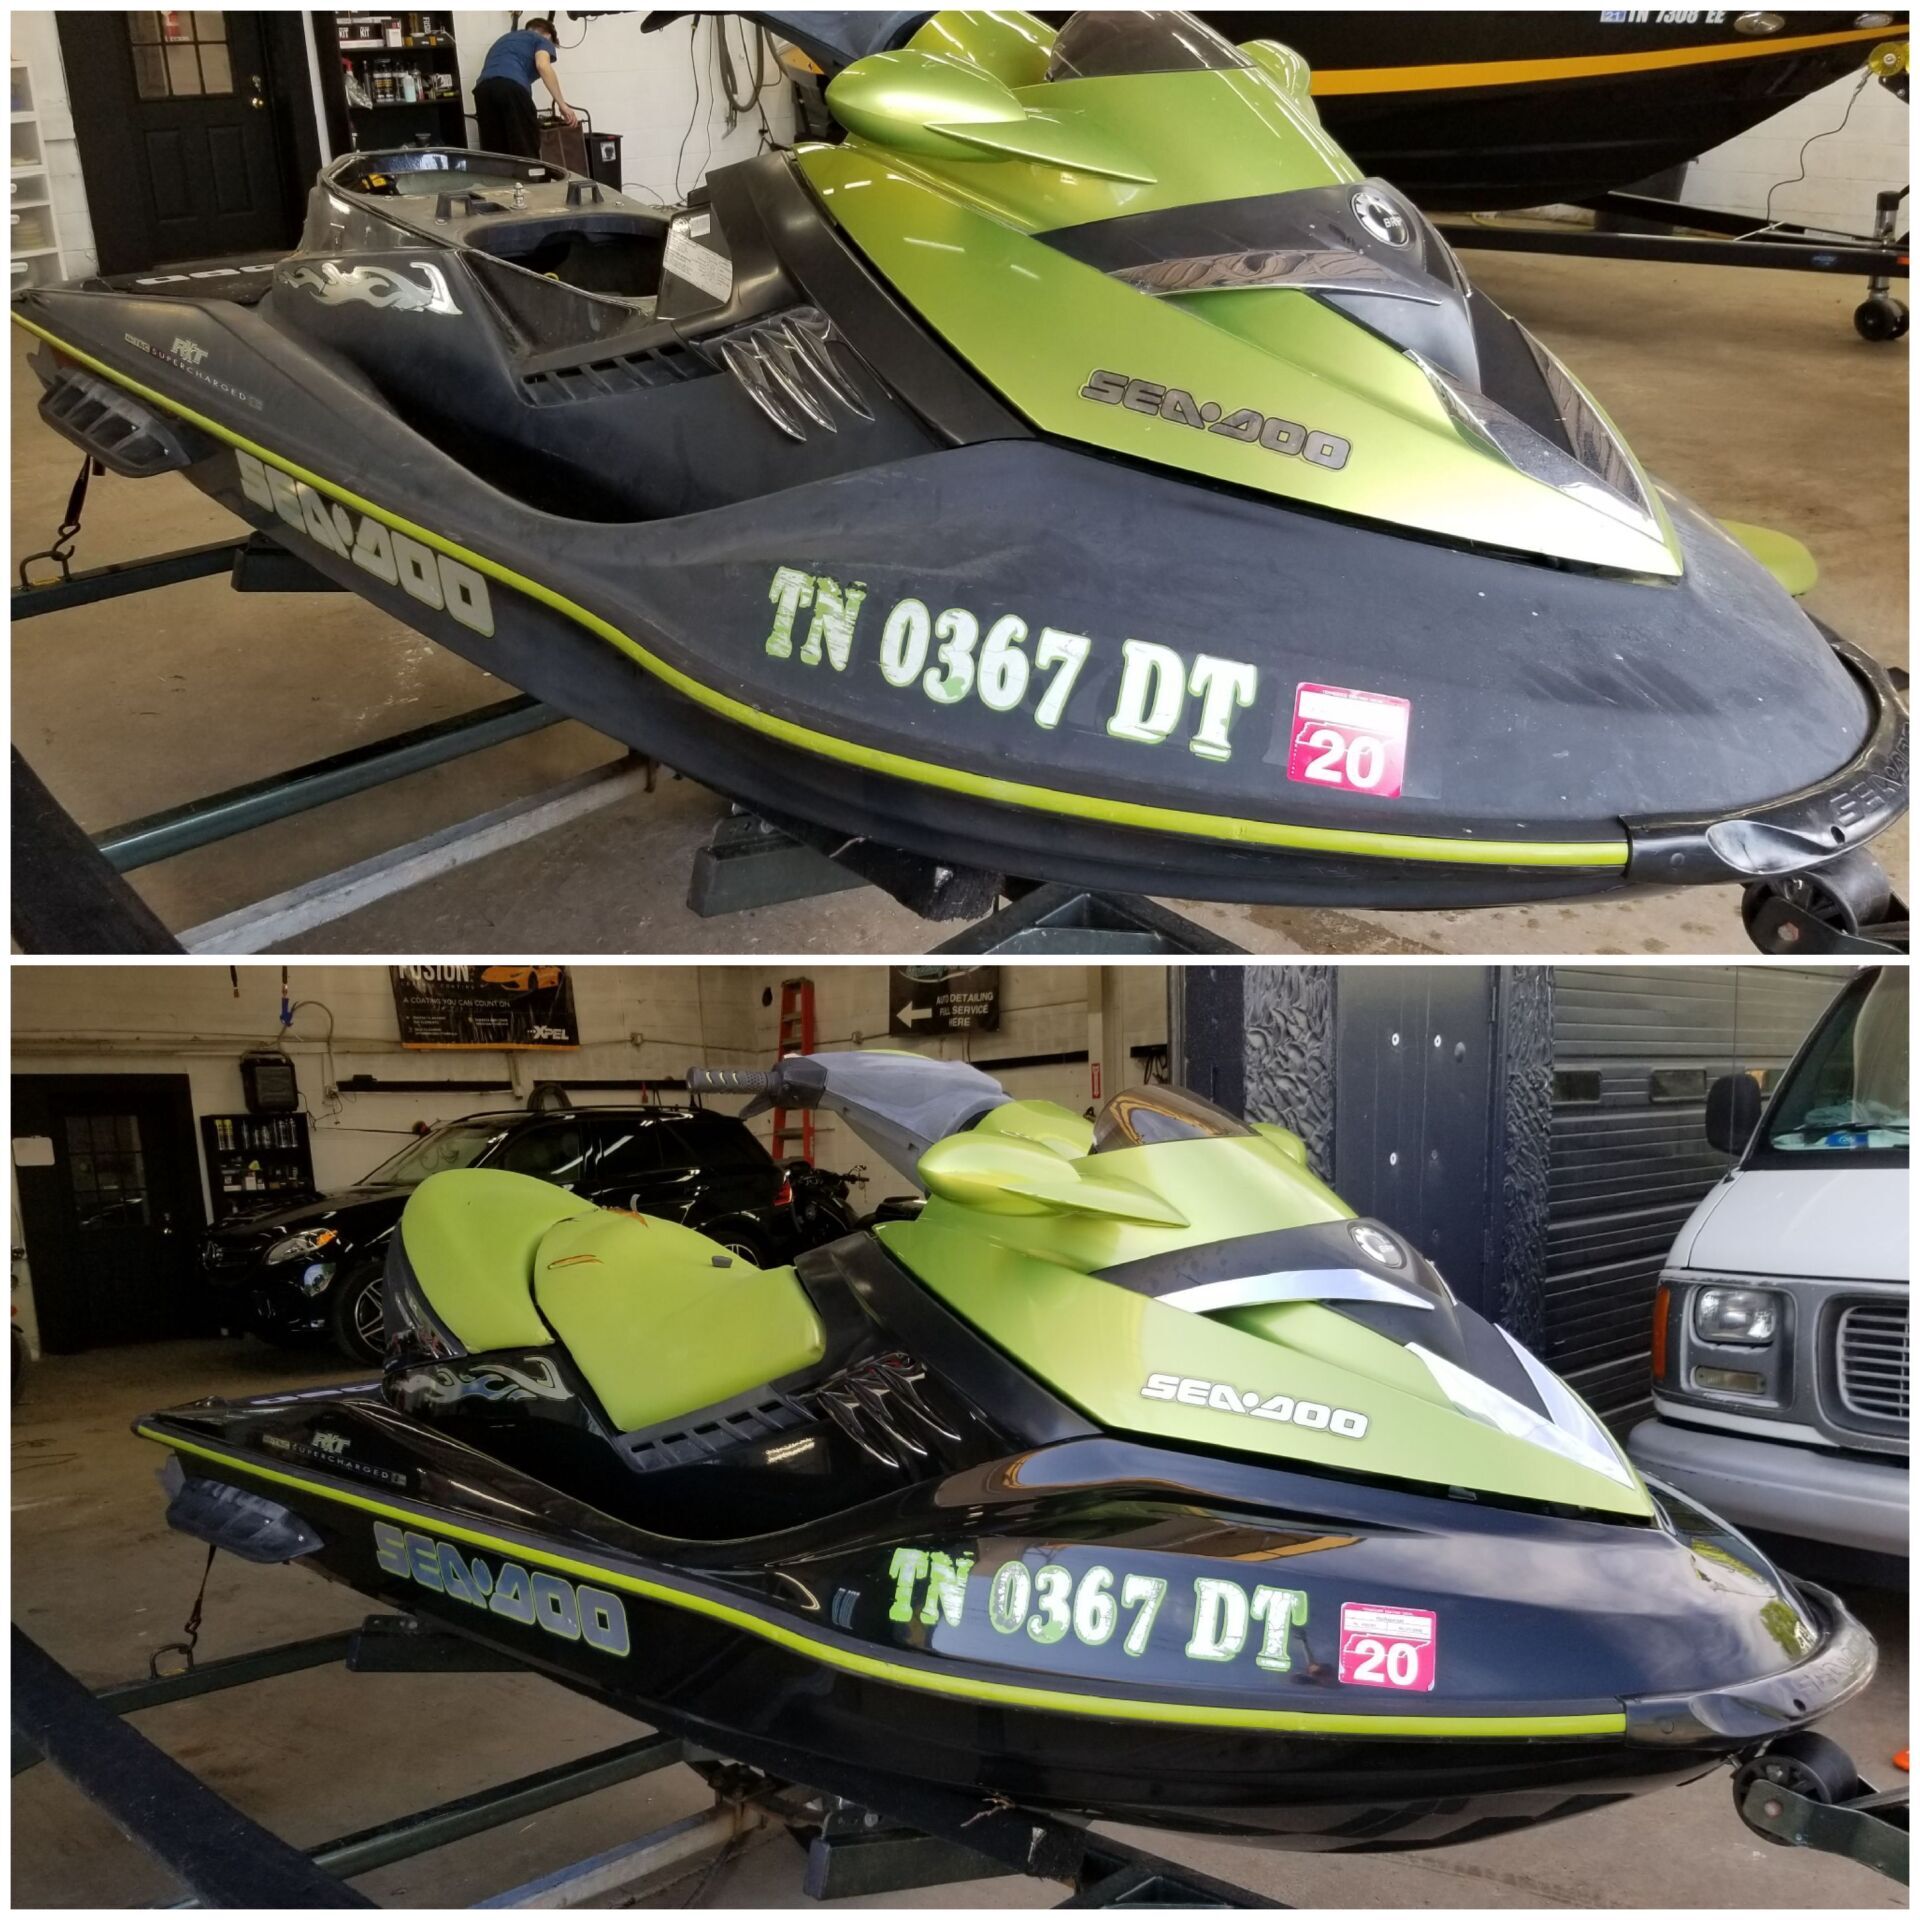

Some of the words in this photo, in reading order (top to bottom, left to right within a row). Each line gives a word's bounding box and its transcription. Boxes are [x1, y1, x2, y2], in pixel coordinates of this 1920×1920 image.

[152, 346, 247, 401] SUPERCHARGED
[766, 566, 868, 671] TN
[880, 598, 1091, 730] 0367
[1106, 638, 1258, 761] DT
[1304, 729, 1385, 788] 20
[410, 997, 441, 1005] COATING
[443, 998, 457, 1006] YOU
[458, 999, 474, 1007] CAN
[950, 991, 994, 1003] DETAILING
[951, 1004, 989, 1015] SERVICE
[949, 1017, 971, 1027] HERE
[292, 1442, 389, 1480] SUPERCHARGED
[889, 1547, 974, 1627] TN
[989, 1560, 1168, 1657] 0367
[1185, 1577, 1308, 1672] DT
[1353, 1639, 1419, 1686] 20
